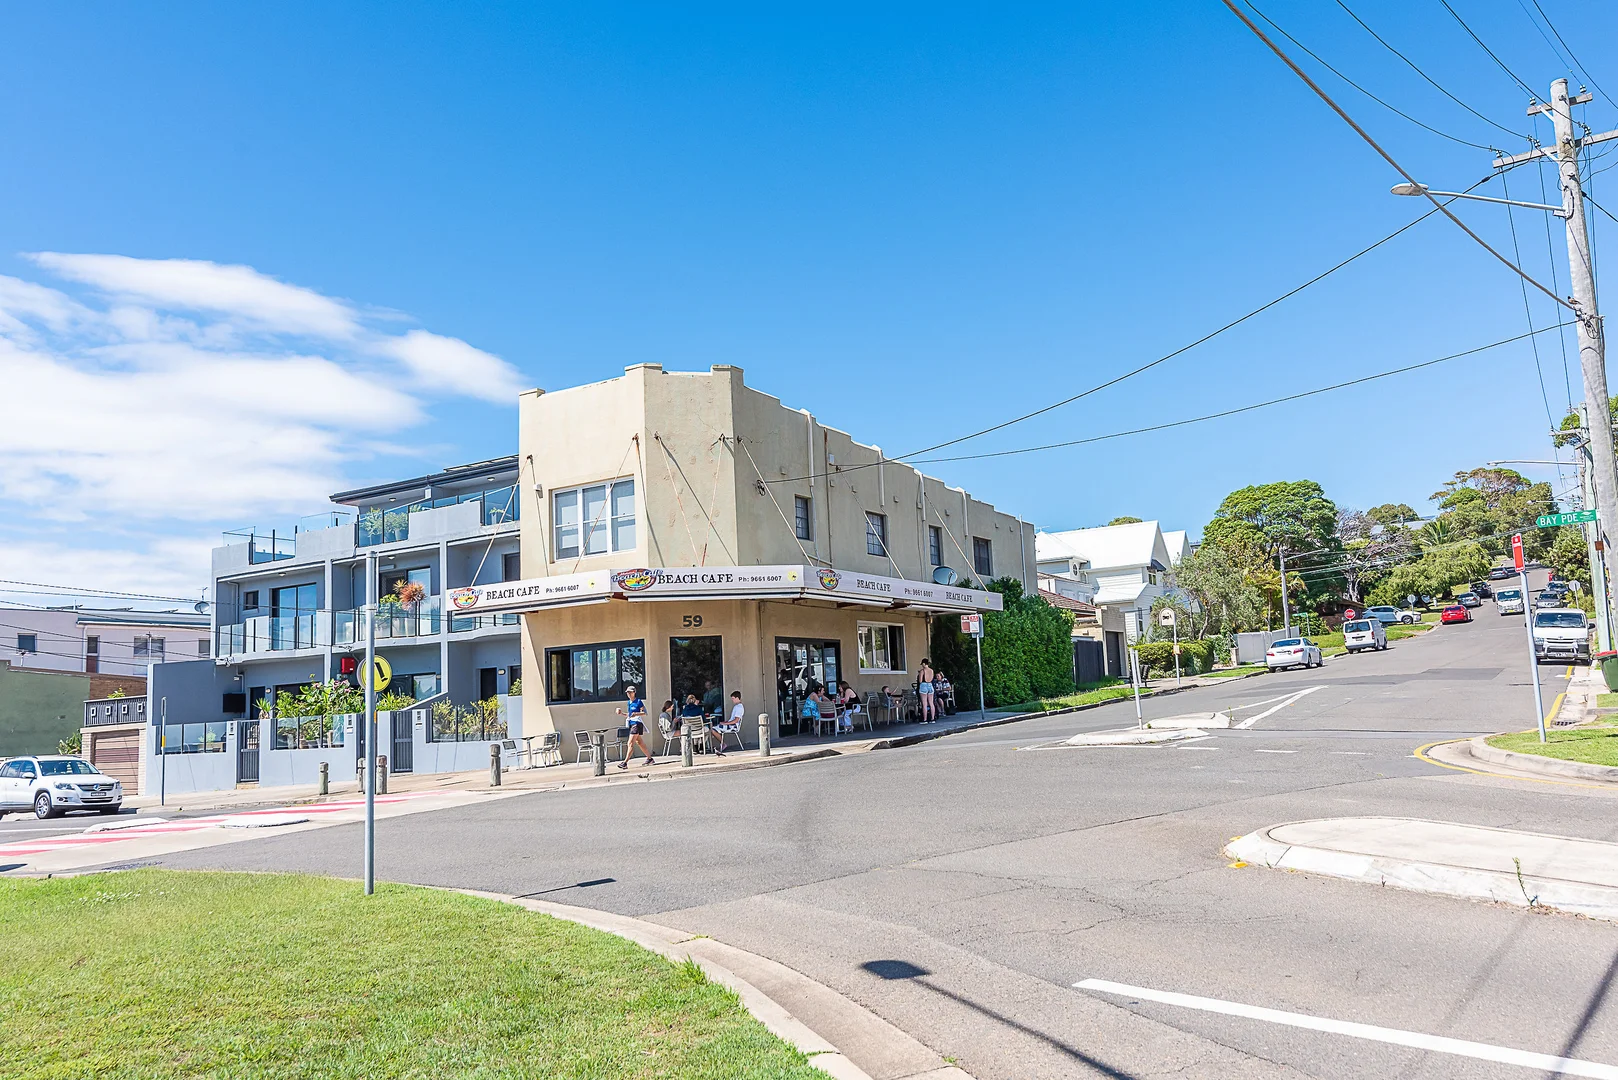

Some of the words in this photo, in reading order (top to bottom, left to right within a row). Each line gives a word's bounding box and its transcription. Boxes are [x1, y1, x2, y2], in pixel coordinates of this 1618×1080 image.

[1540, 516, 1557, 526] BAY
[1561, 513, 1579, 523] PDE
[657, 574, 699, 585] BEACH
[701, 573, 733, 583] CAFE
[856, 579, 876, 590] BEACH
[876, 581, 892, 593] CAFE
[486, 588, 514, 600] BEACH
[516, 586, 540, 597] CAFE
[945, 591, 961, 602] BEACH
[961, 593, 973, 603] CAFE
[682, 614, 703, 628] 59
